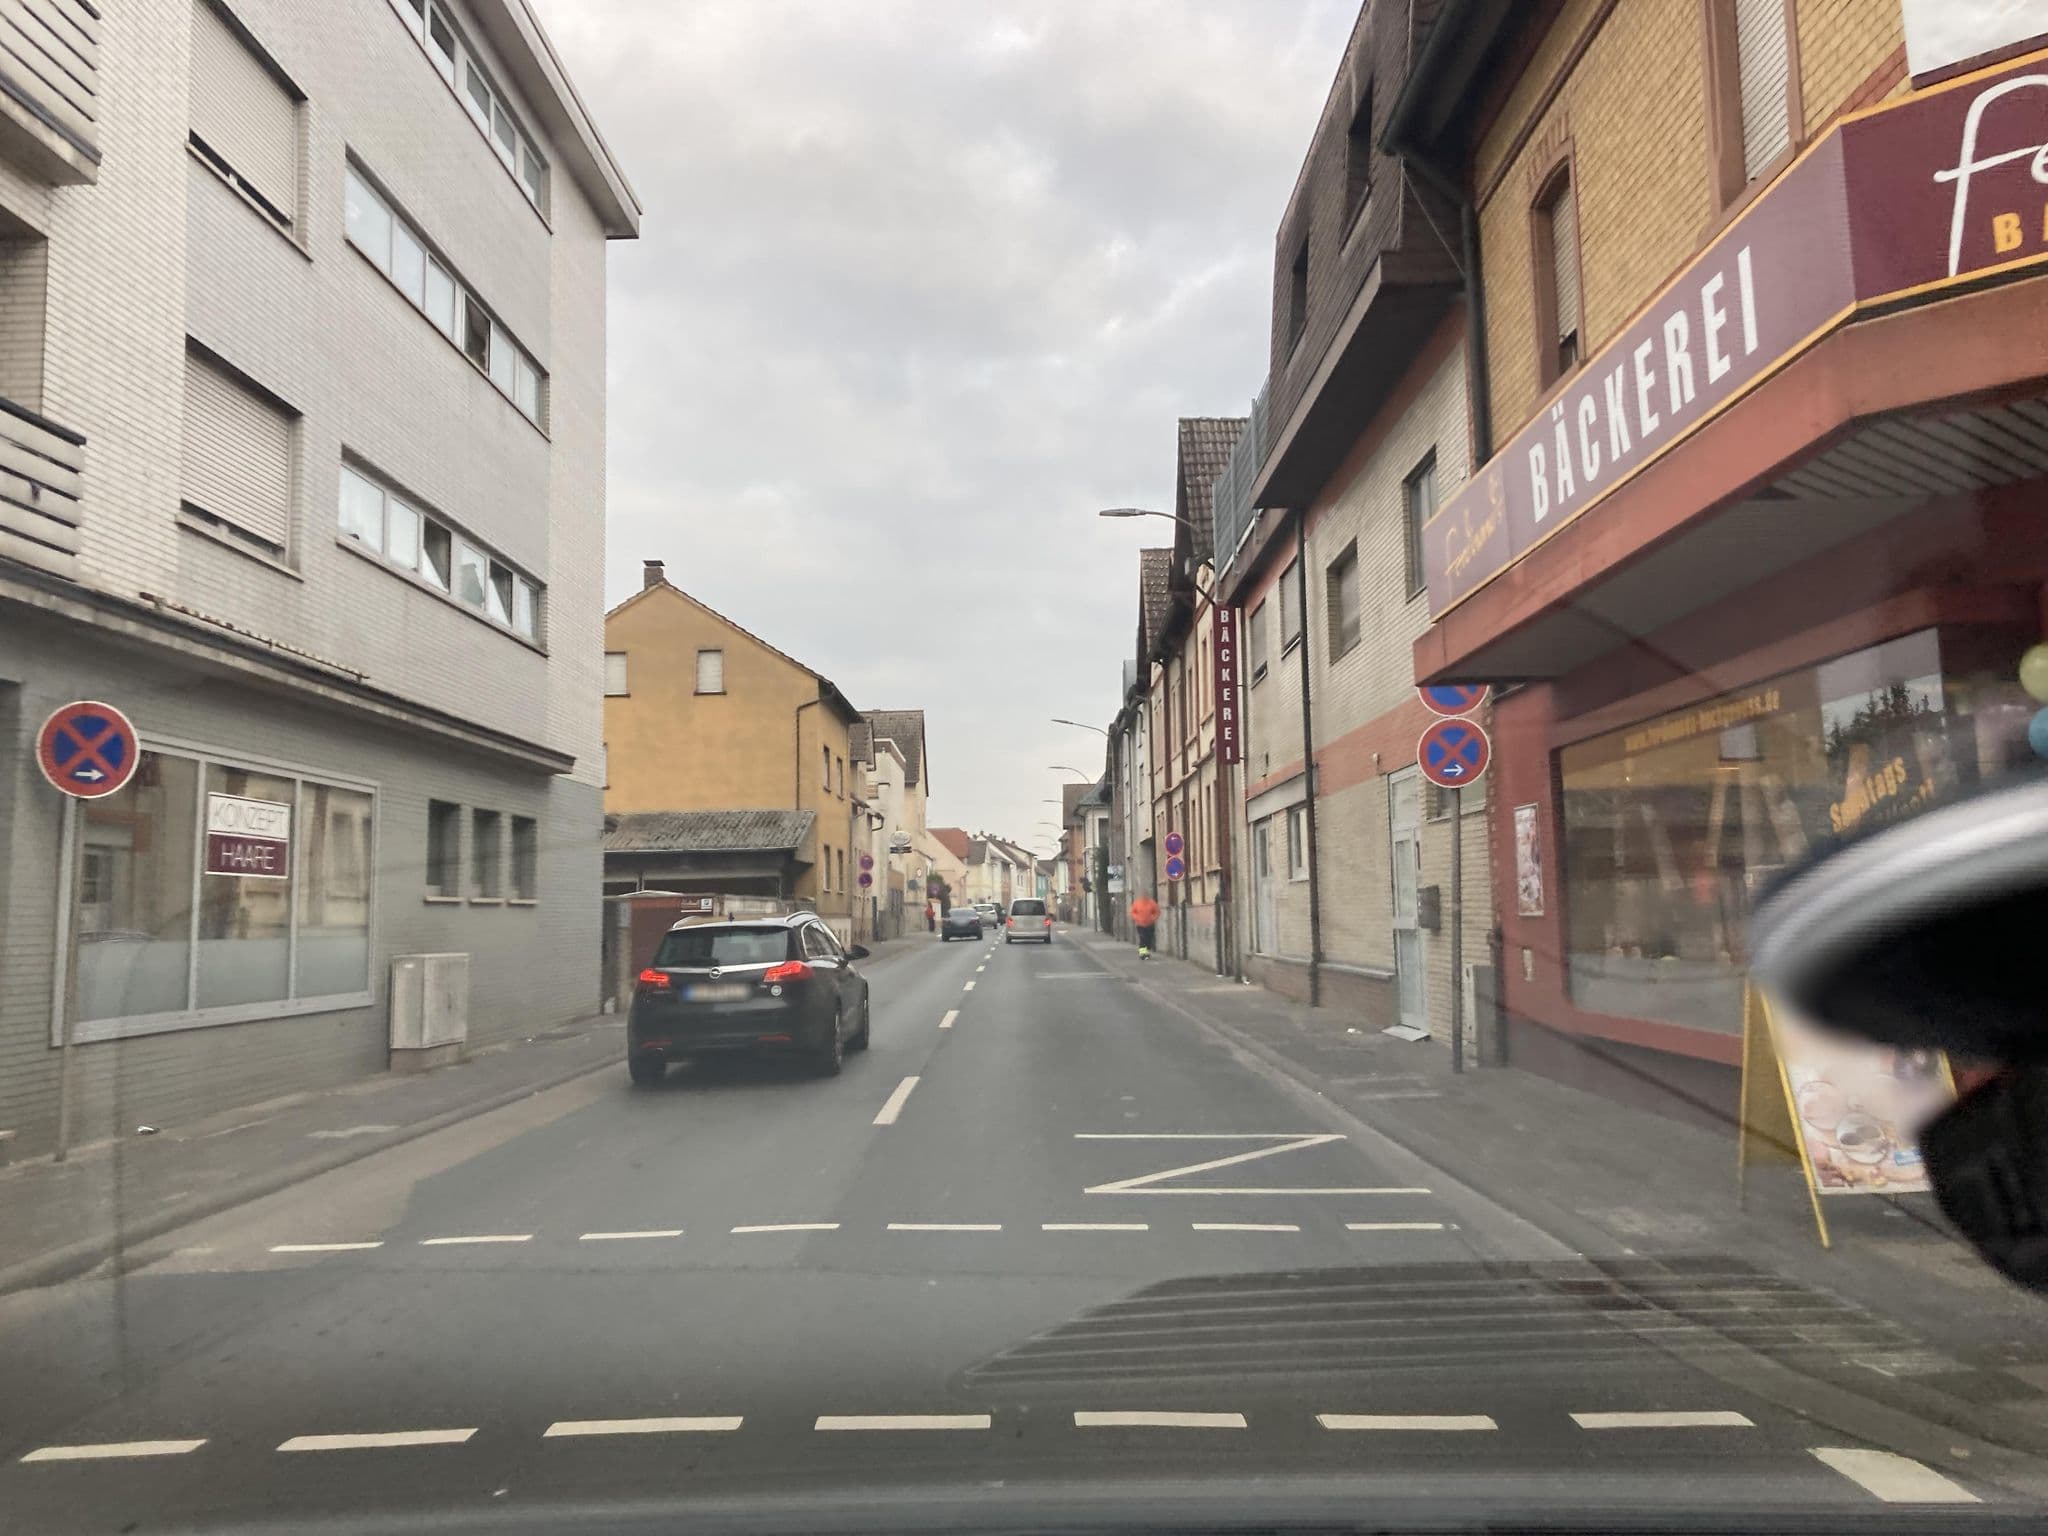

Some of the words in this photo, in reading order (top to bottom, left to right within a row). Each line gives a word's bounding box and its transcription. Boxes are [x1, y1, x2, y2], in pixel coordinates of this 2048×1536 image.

[1992, 202, 2048, 254] B
[1529, 246, 1759, 523] BÄCKEREI
[1220, 609, 1232, 760] BÄCKEREI
[212, 802, 285, 832] KONZEPT
[221, 842, 275, 869] HAARE
